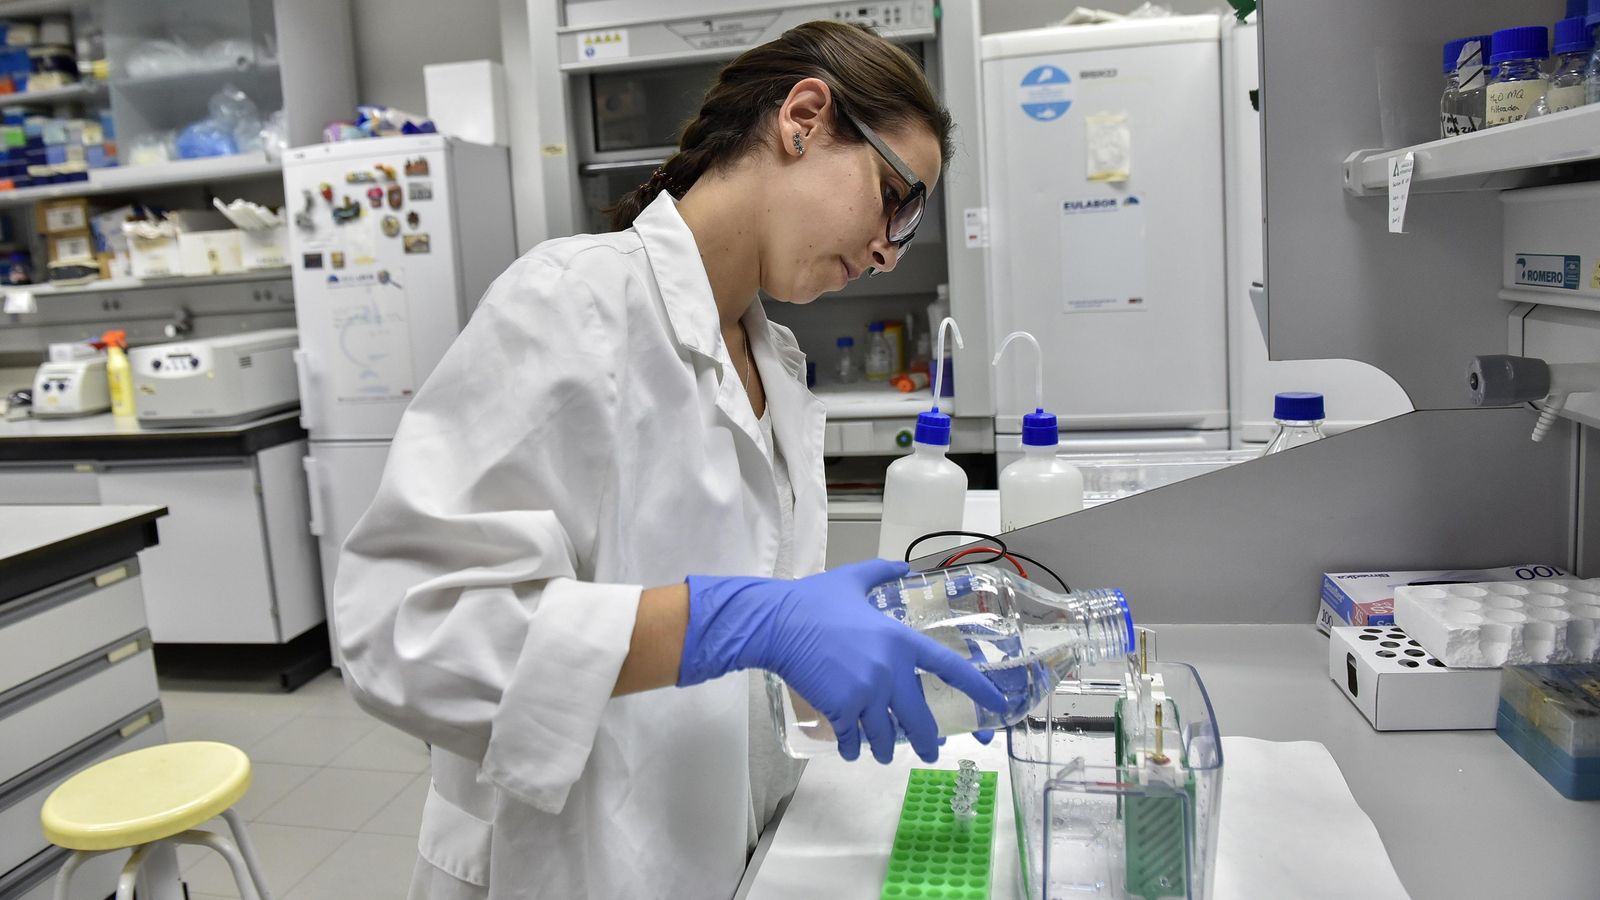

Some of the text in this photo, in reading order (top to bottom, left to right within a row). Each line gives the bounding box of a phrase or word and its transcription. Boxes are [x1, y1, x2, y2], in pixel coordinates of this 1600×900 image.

[1063, 200, 1118, 210] EULABOR
[1527, 270, 1564, 284] ROMERO
[1515, 565, 1565, 580] 100
[876, 593, 888, 609] 500
[1321, 608, 1334, 628] 100
